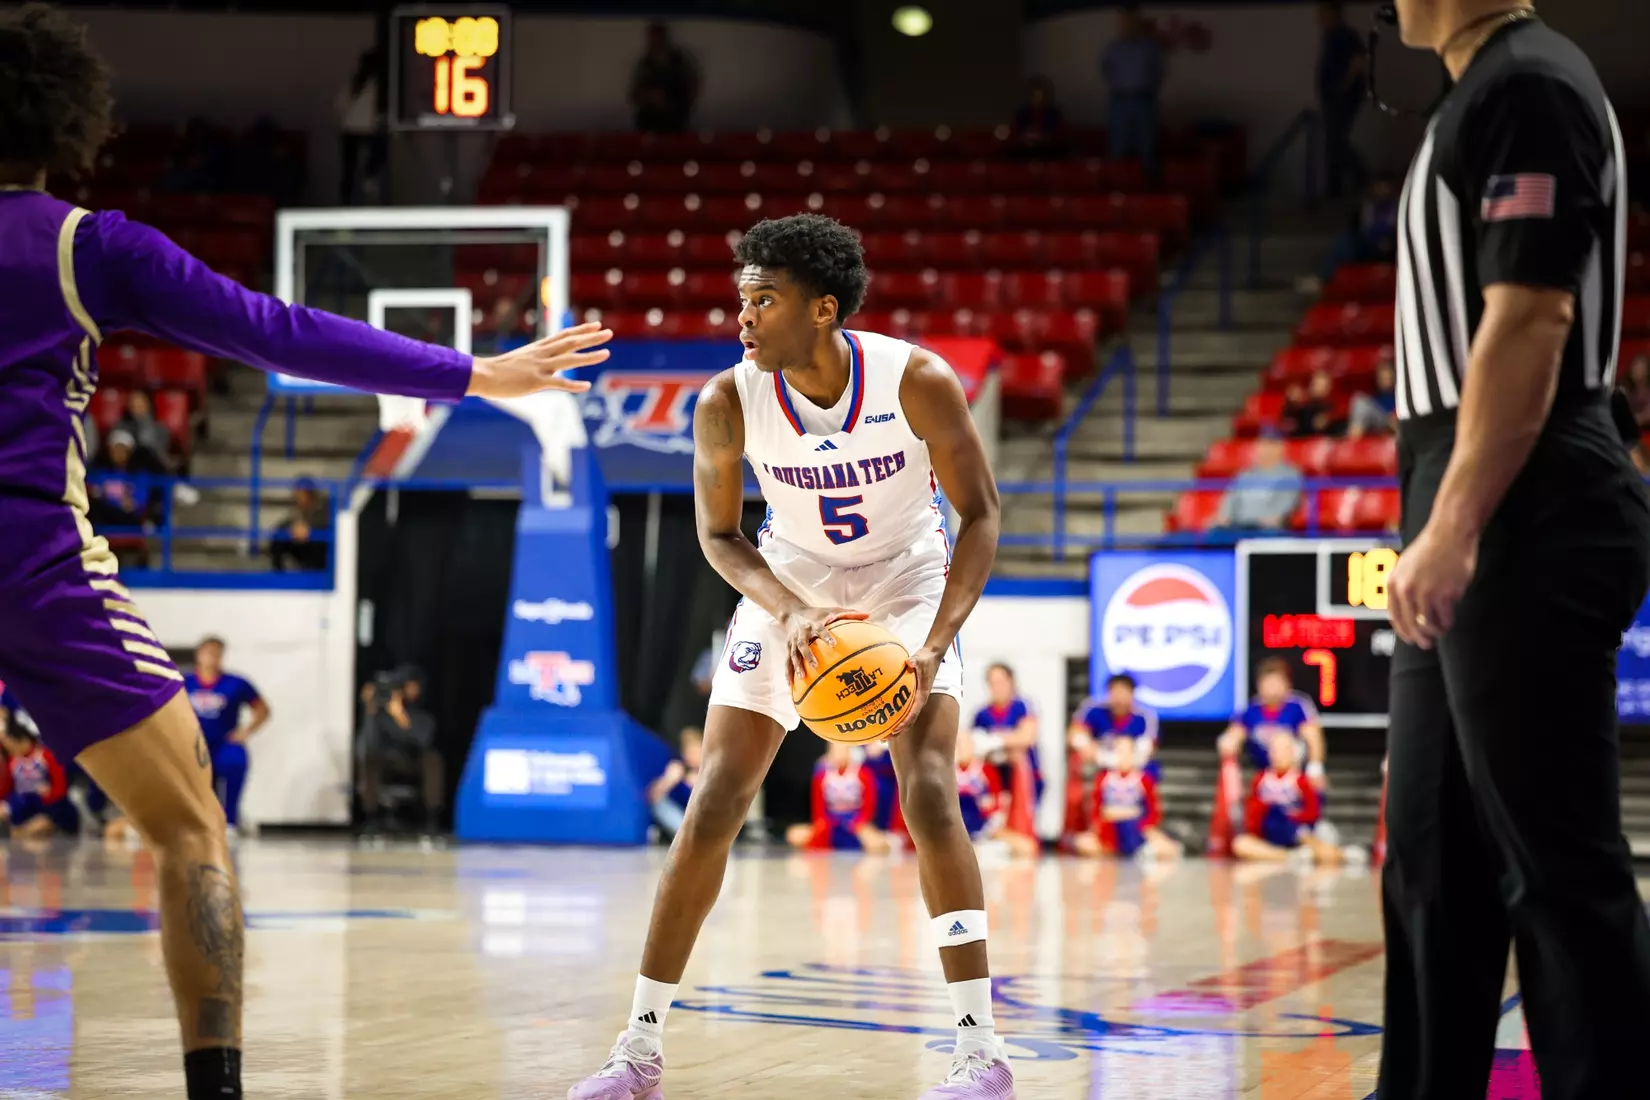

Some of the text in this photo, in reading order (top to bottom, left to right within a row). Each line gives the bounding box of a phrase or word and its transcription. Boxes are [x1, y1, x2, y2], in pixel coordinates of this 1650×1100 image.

[434, 55, 488, 117] 16
[857, 450, 906, 485] TECH
[818, 494, 869, 545] 5
[1303, 649, 1336, 707] 7
[835, 684, 911, 734] Wilson
